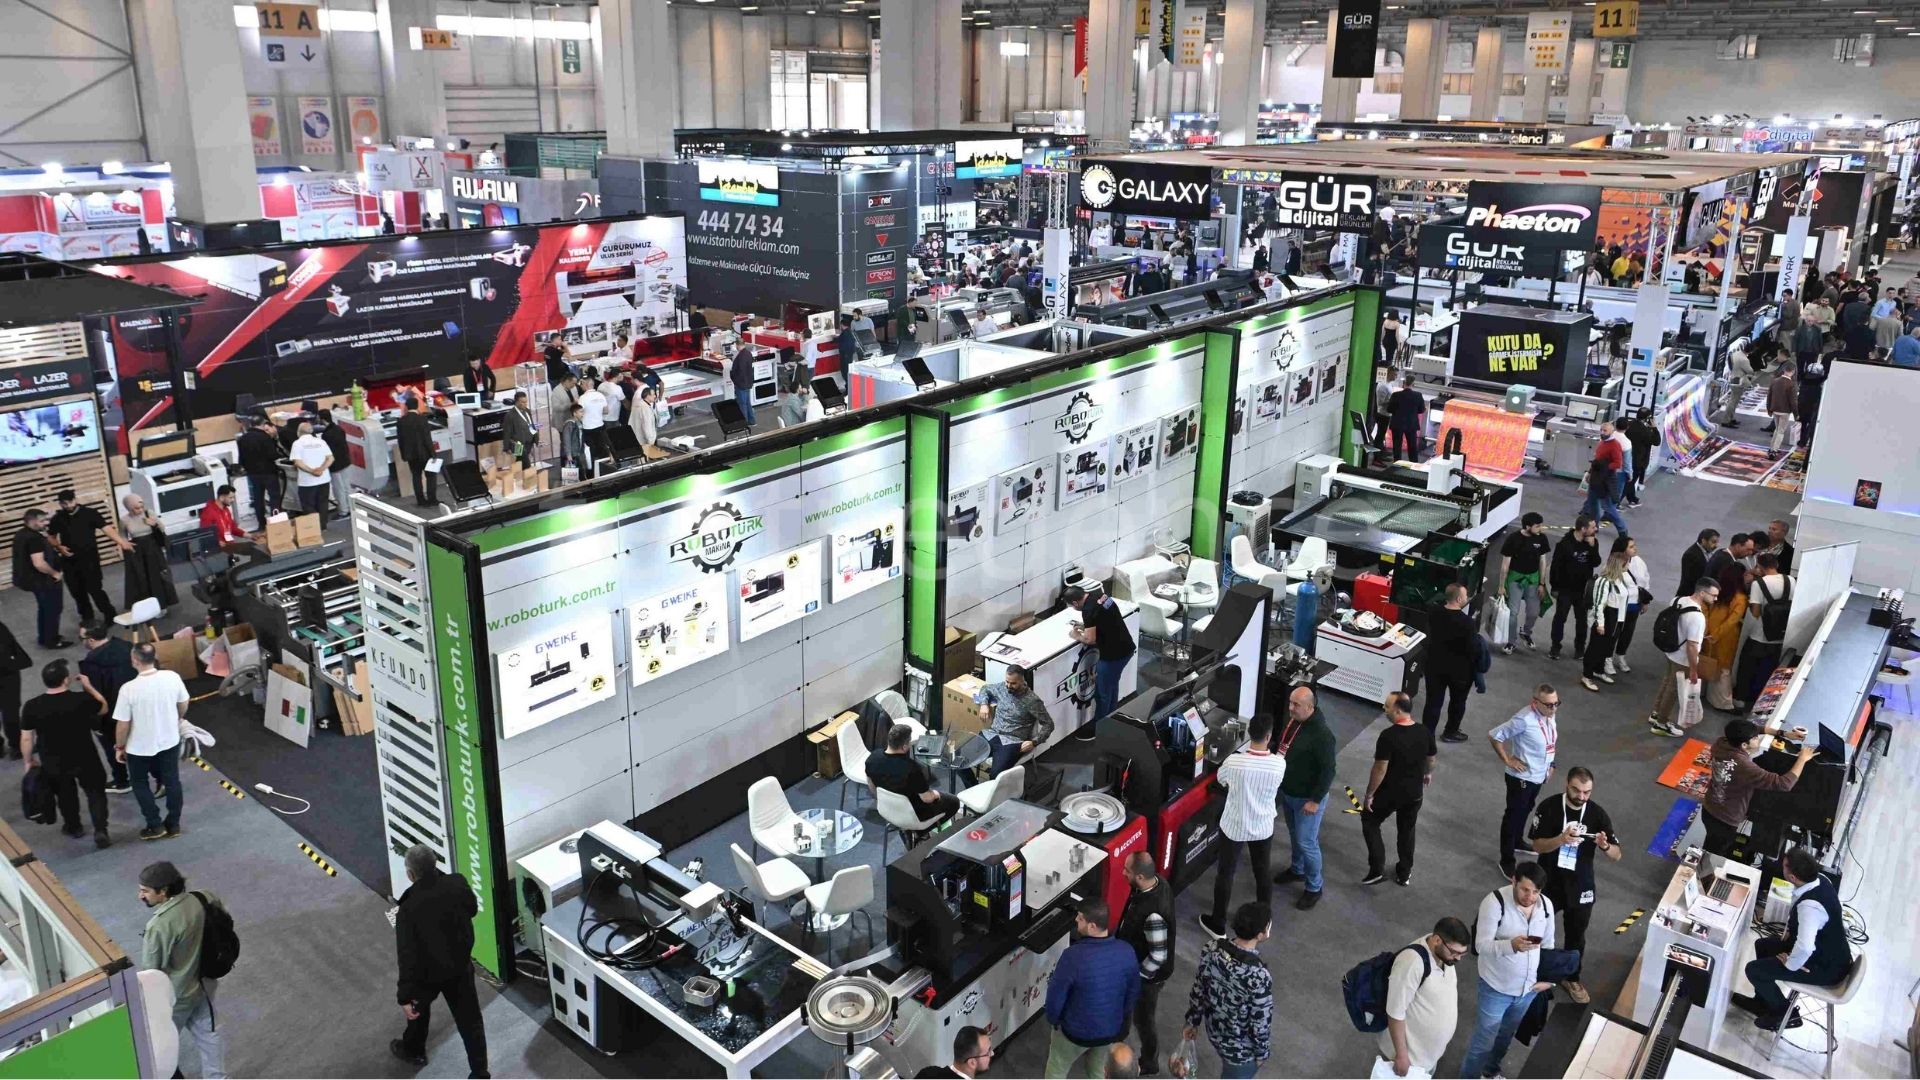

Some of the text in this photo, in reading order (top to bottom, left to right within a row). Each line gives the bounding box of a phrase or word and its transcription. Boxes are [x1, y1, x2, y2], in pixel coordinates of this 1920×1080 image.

[260, 9, 313, 31] 11 A
[1343, 12, 1373, 25] GÜR
[1599, 8, 1623, 28] 11
[452, 176, 518, 203] FUJIFILM
[1118, 178, 1209, 206] GALAXY
[1279, 175, 1372, 215] GÜR
[697, 209, 784, 239] 444 74 34
[1293, 208, 1339, 228] dijital
[1340, 213, 1367, 222] REKLAM
[1465, 203, 1582, 234] Phaeton
[602, 241, 652, 253] GURURUMUZ
[1457, 253, 1496, 270] dijital
[1783, 255, 1796, 288] MARK
[1487, 332, 1542, 352] KUTU DA
[1489, 356, 1507, 372] NE
[1510, 354, 1538, 372] VAR
[33, 371, 69, 385] LAZER
[804, 482, 902, 525] www.roboturk.com.tr
[670, 515, 764, 558] ROBOTÜRK
[371, 646, 426, 691] KEUNDO
[446, 612, 485, 913] www.roboturk.com.tr
